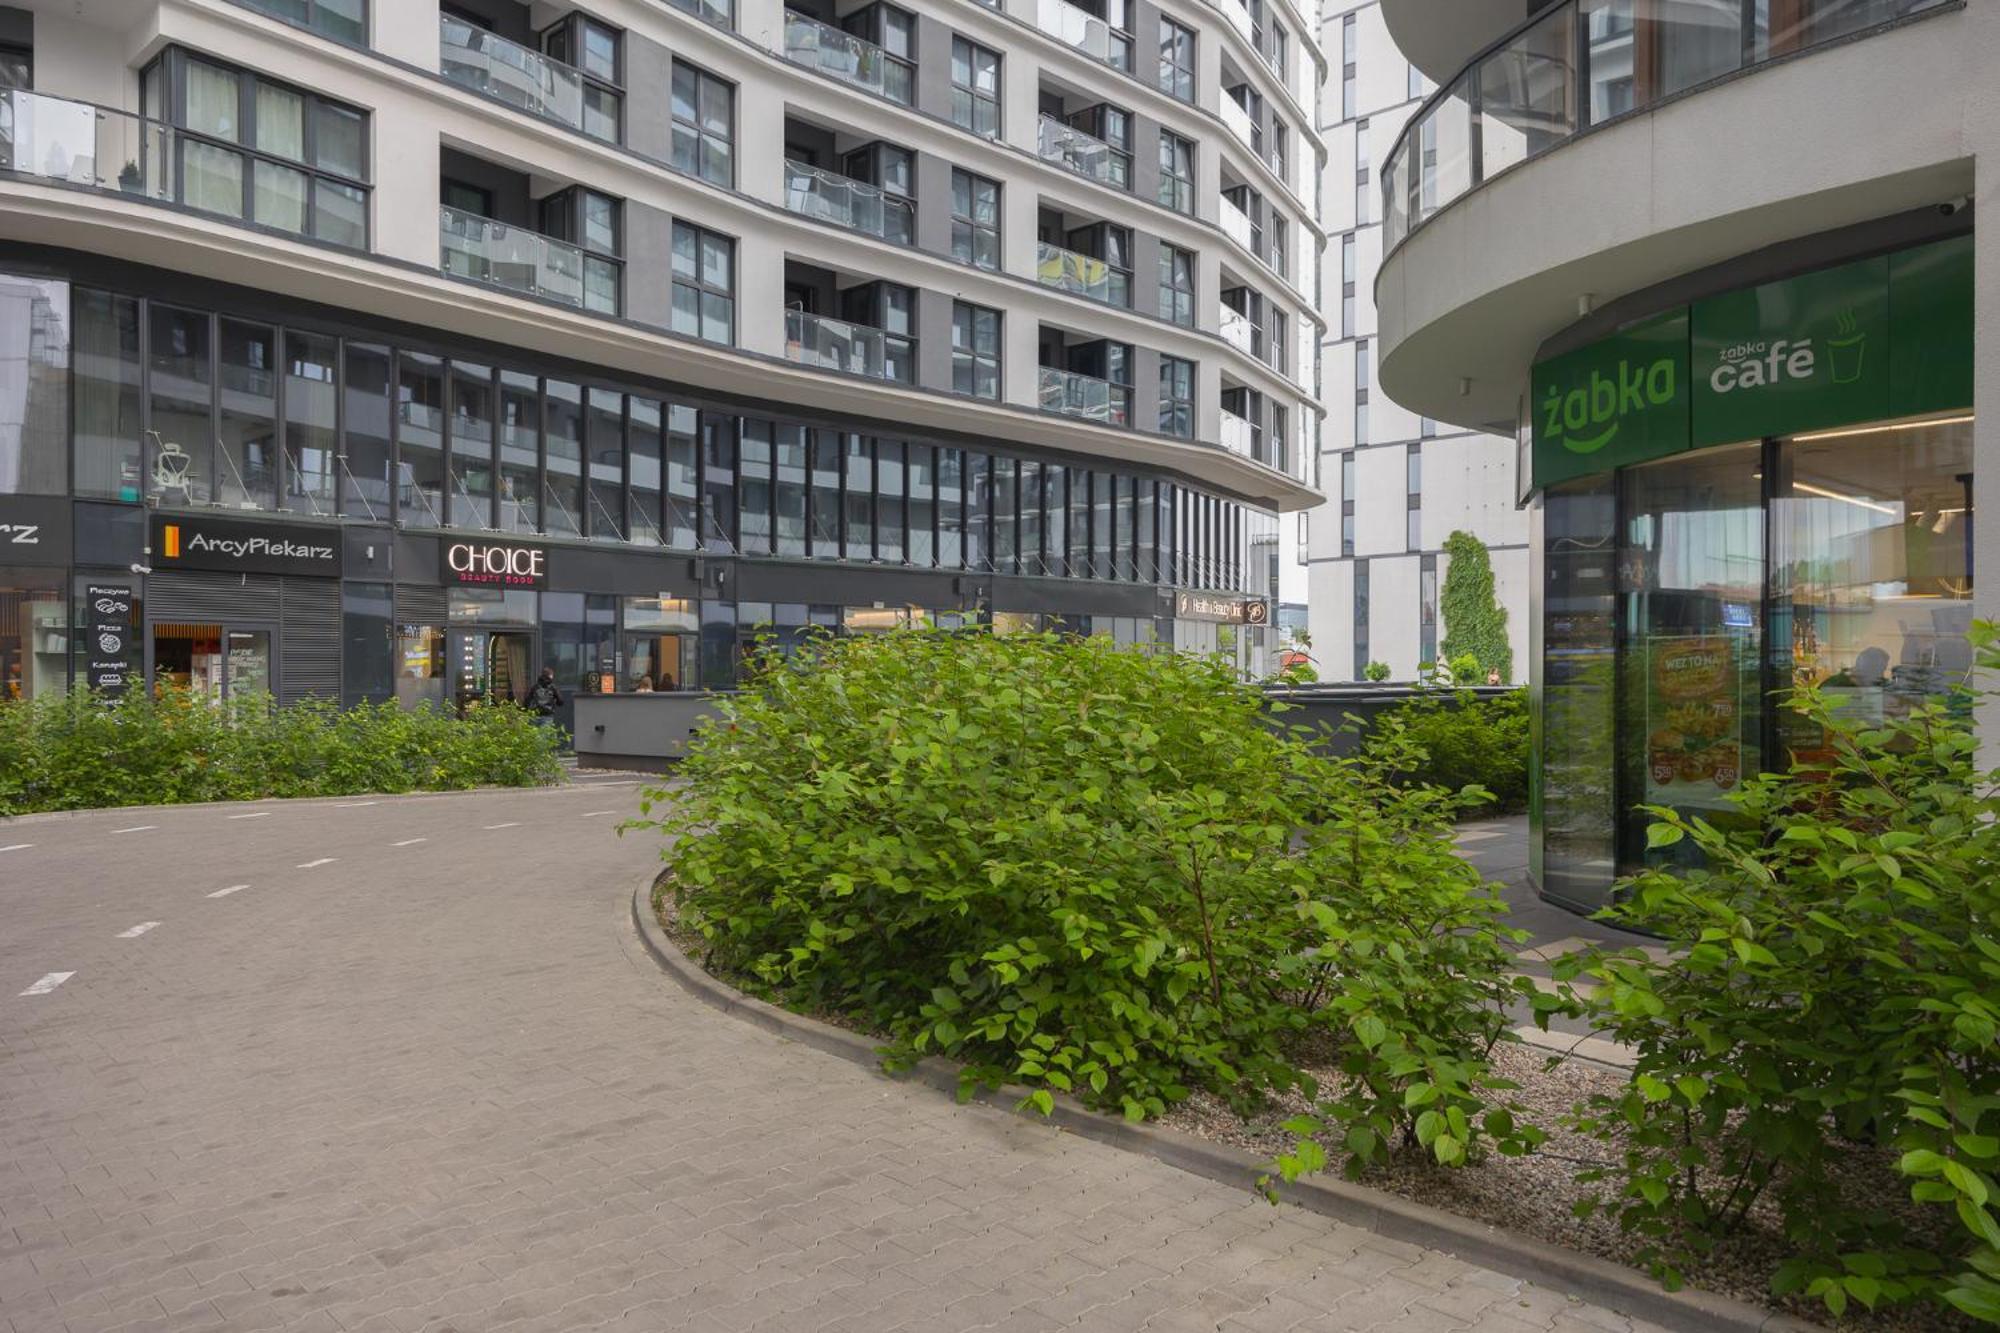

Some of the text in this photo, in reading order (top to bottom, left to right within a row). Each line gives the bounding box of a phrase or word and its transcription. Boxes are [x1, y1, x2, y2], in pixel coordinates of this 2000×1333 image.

[1543, 359, 1675, 437] żabka
[188, 533, 333, 559] ArcyPiekarz
[448, 544, 544, 576] CHOICE
[460, 573, 534, 584] BEAUTY ROOM
[98, 624, 122, 632] Pizza
[93, 661, 128, 670] Kanapki
